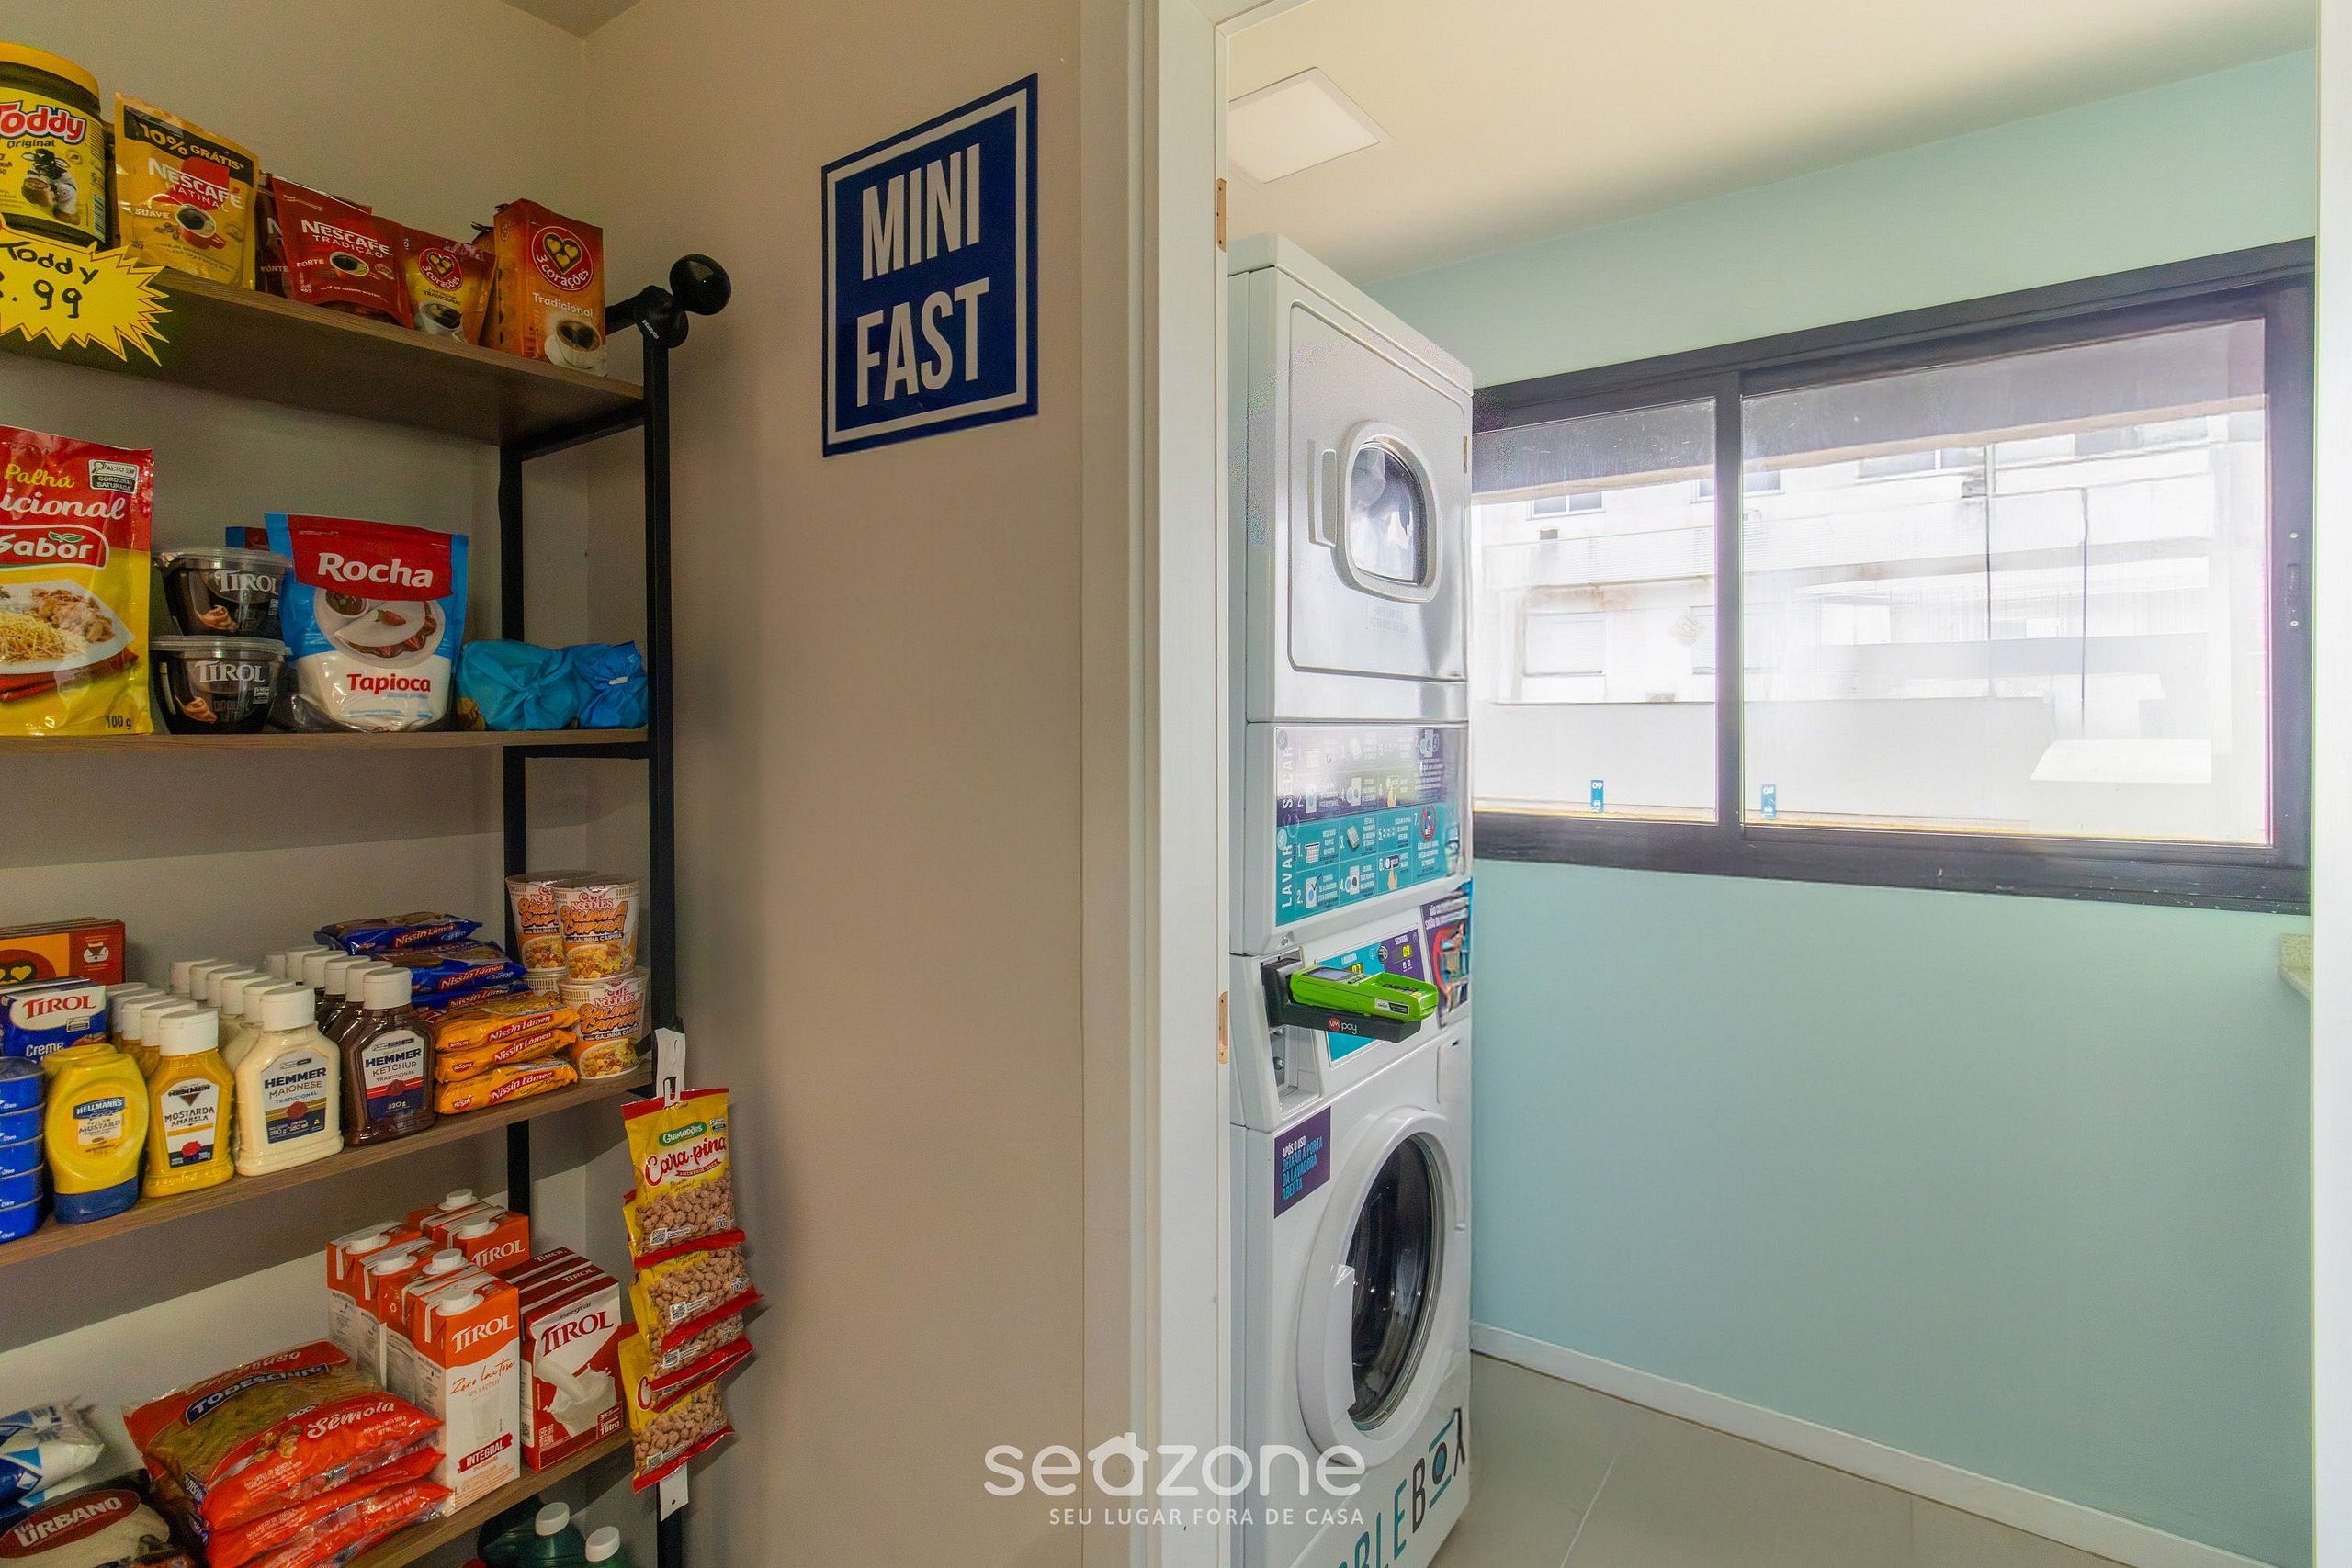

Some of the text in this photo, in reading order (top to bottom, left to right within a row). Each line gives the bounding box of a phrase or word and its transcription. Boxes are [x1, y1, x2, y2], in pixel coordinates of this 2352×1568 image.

[7, 140, 55, 149] Original
[139, 122, 188, 155] 10%
[166, 182, 229, 213] MATINAL
[135, 208, 172, 220] SUAVE
[862, 143, 980, 282] MINI
[0, 241, 99, 285] Toddy
[297, 258, 325, 268] FORTE
[537, 254, 589, 288] 3 corações
[0, 271, 83, 319] .99
[533, 292, 594, 317] Tradicional
[857, 277, 989, 408] FAST
[5, 464, 74, 488] Palha
[317, 552, 434, 588] Rocha
[214, 570, 279, 595] TIROL
[195, 660, 265, 683] TIROL
[346, 673, 431, 694] Tapioca
[1281, 842, 1293, 908] LAVAR
[571, 898, 614, 911] NOODLES
[395, 931, 427, 948] Nissin
[441, 973, 474, 990] Nissin
[22, 995, 96, 1019] TIROL
[594, 992, 635, 1008] NOODLES
[489, 1024, 520, 1042] Nissin
[1341, 1022, 1358, 1035] pay
[26, 1041, 65, 1057] Creme
[366, 1048, 422, 1068] HEMMER
[494, 1042, 523, 1062] Nissin
[264, 1067, 327, 1089] HEMMER
[372, 1061, 417, 1077] KETCHUP
[269, 1080, 322, 1100] MAIONESE
[491, 1078, 520, 1100] Nissin
[164, 1106, 215, 1123] MOSTARDA
[171, 1115, 209, 1128] AMARELA
[79, 1121, 121, 1134] MUSTARD
[1306, 1135, 1323, 1157] PORTA
[471, 1240, 526, 1269] TIROL
[451, 1314, 514, 1354] TIROL
[541, 1311, 615, 1358] TIROL
[307, 1401, 395, 1439] Sêmola
[466, 1439, 504, 1467] INTEGRAL
[1339, 1407, 1466, 1568] LEBOX
[14, 1496, 122, 1548] URBANO
